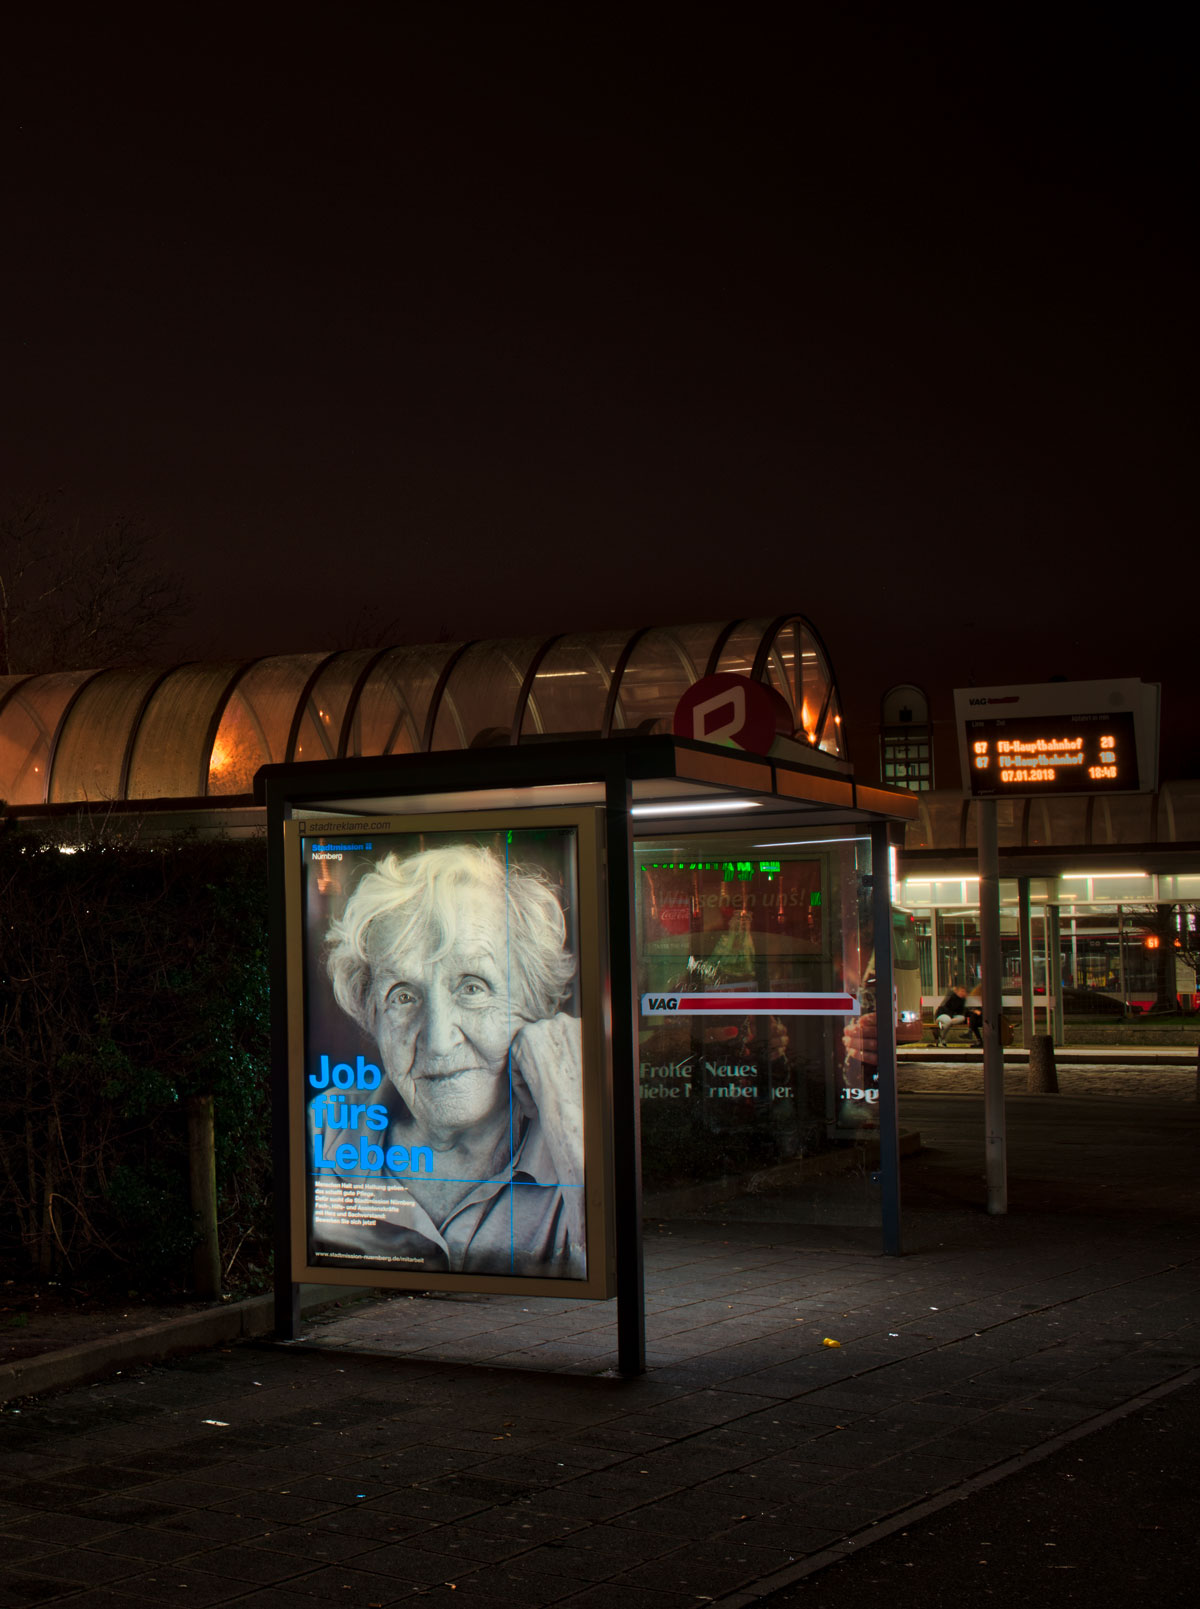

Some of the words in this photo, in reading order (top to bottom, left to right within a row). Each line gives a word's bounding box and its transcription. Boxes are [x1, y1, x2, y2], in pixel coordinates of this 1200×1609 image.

[968, 697, 987, 705] VAG
[974, 741, 988, 754] 67
[1001, 768, 1055, 782] 07.01.2018
[309, 822, 391, 832] stadtreklame.com
[311, 843, 364, 852] Stadtmission
[311, 852, 343, 861] Nürnberg
[648, 998, 678, 1010] VAG
[308, 1055, 382, 1090] Job
[705, 1062, 758, 1077] Neues
[311, 1094, 389, 1131] fürs
[313, 1133, 434, 1173] Leben
